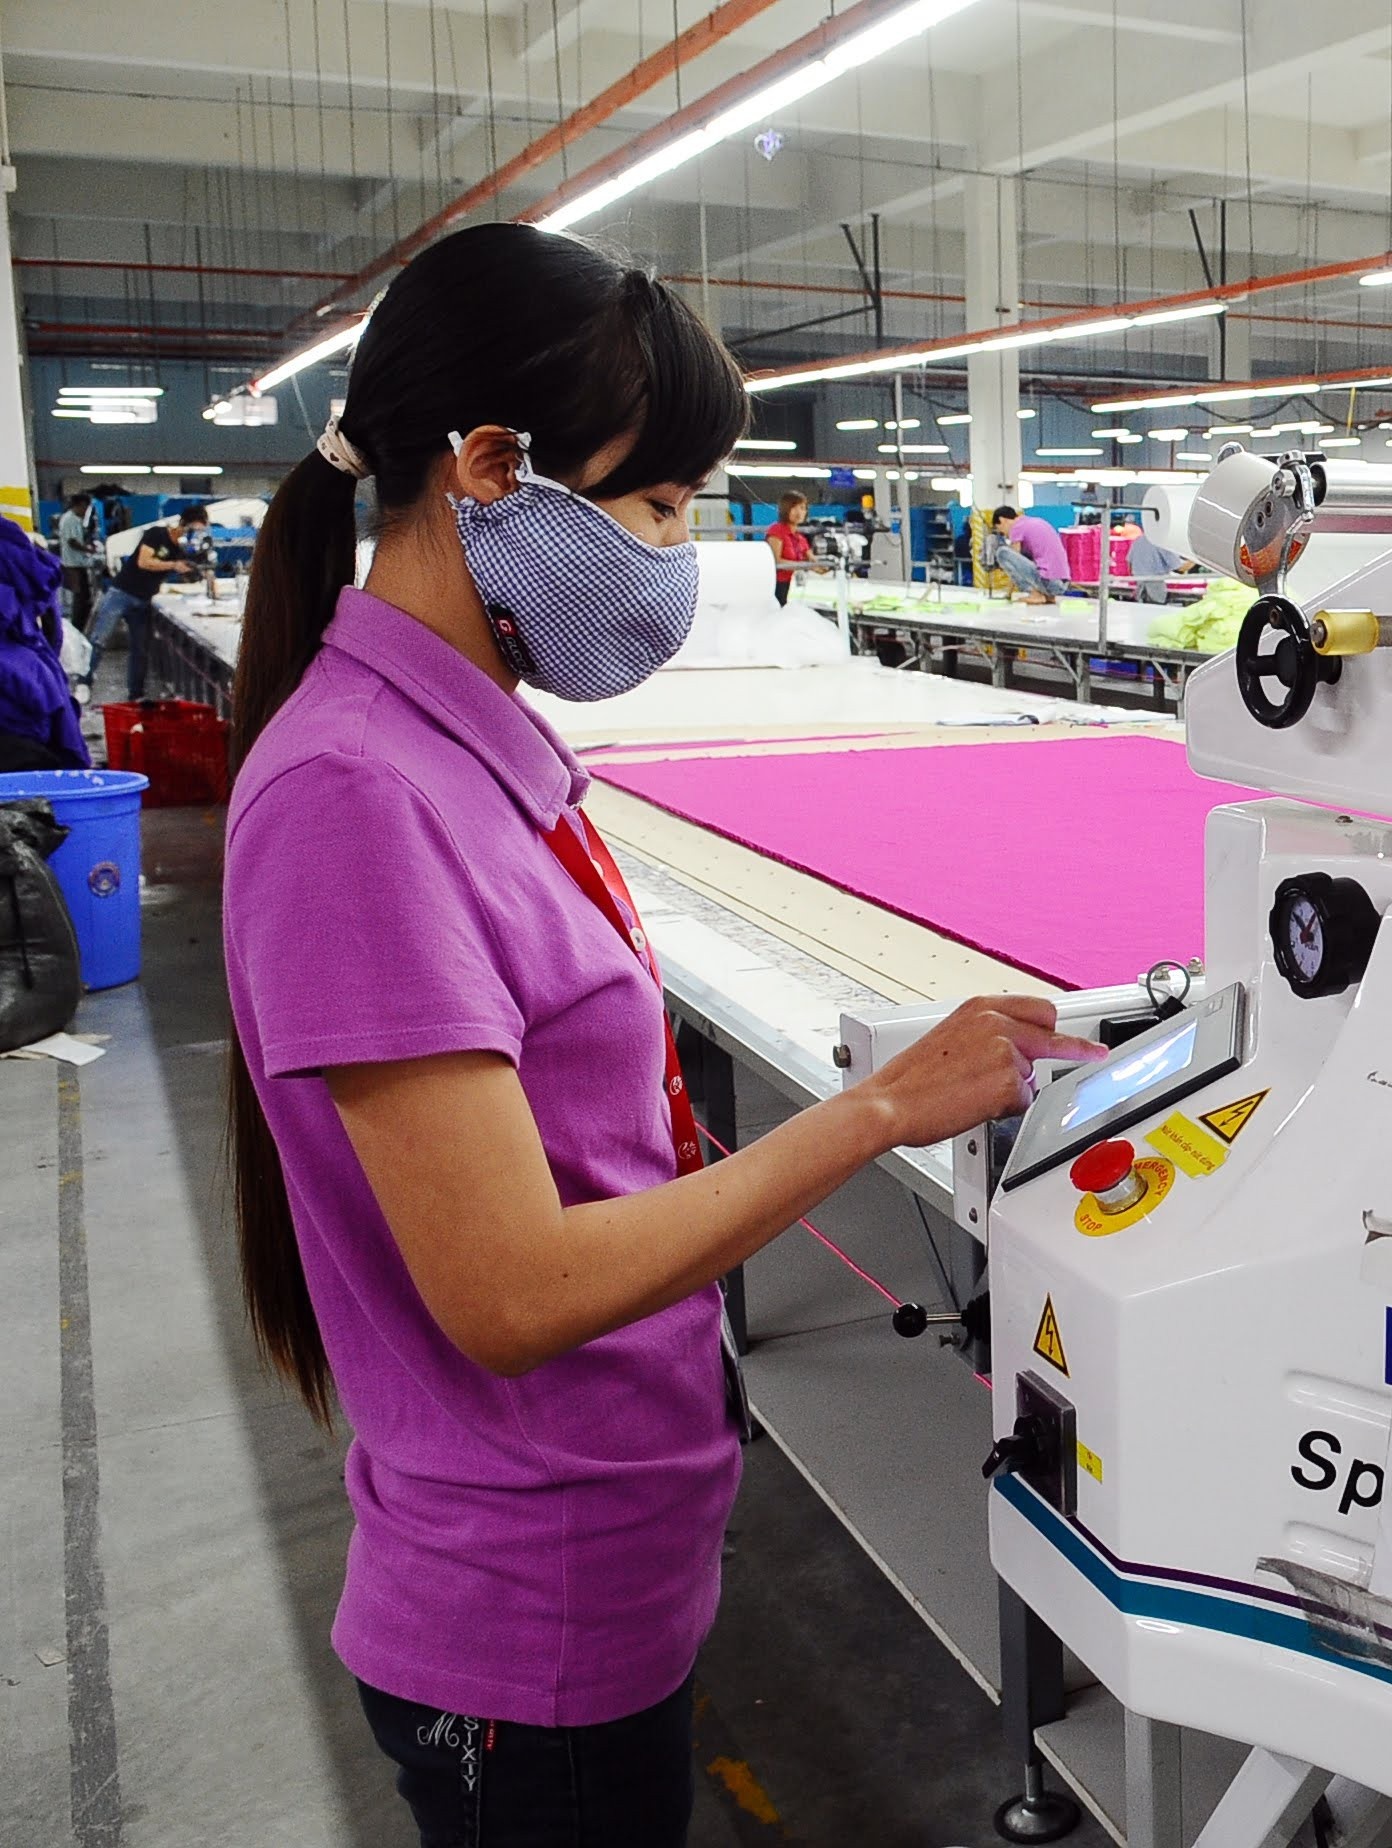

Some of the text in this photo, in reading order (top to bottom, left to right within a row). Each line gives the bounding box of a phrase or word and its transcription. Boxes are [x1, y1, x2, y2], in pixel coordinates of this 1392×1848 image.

[1134, 1161, 1169, 1196] MERGENCY
[1080, 1214, 1102, 1231] STOP
[461, 1715, 480, 1791] SIXTY
